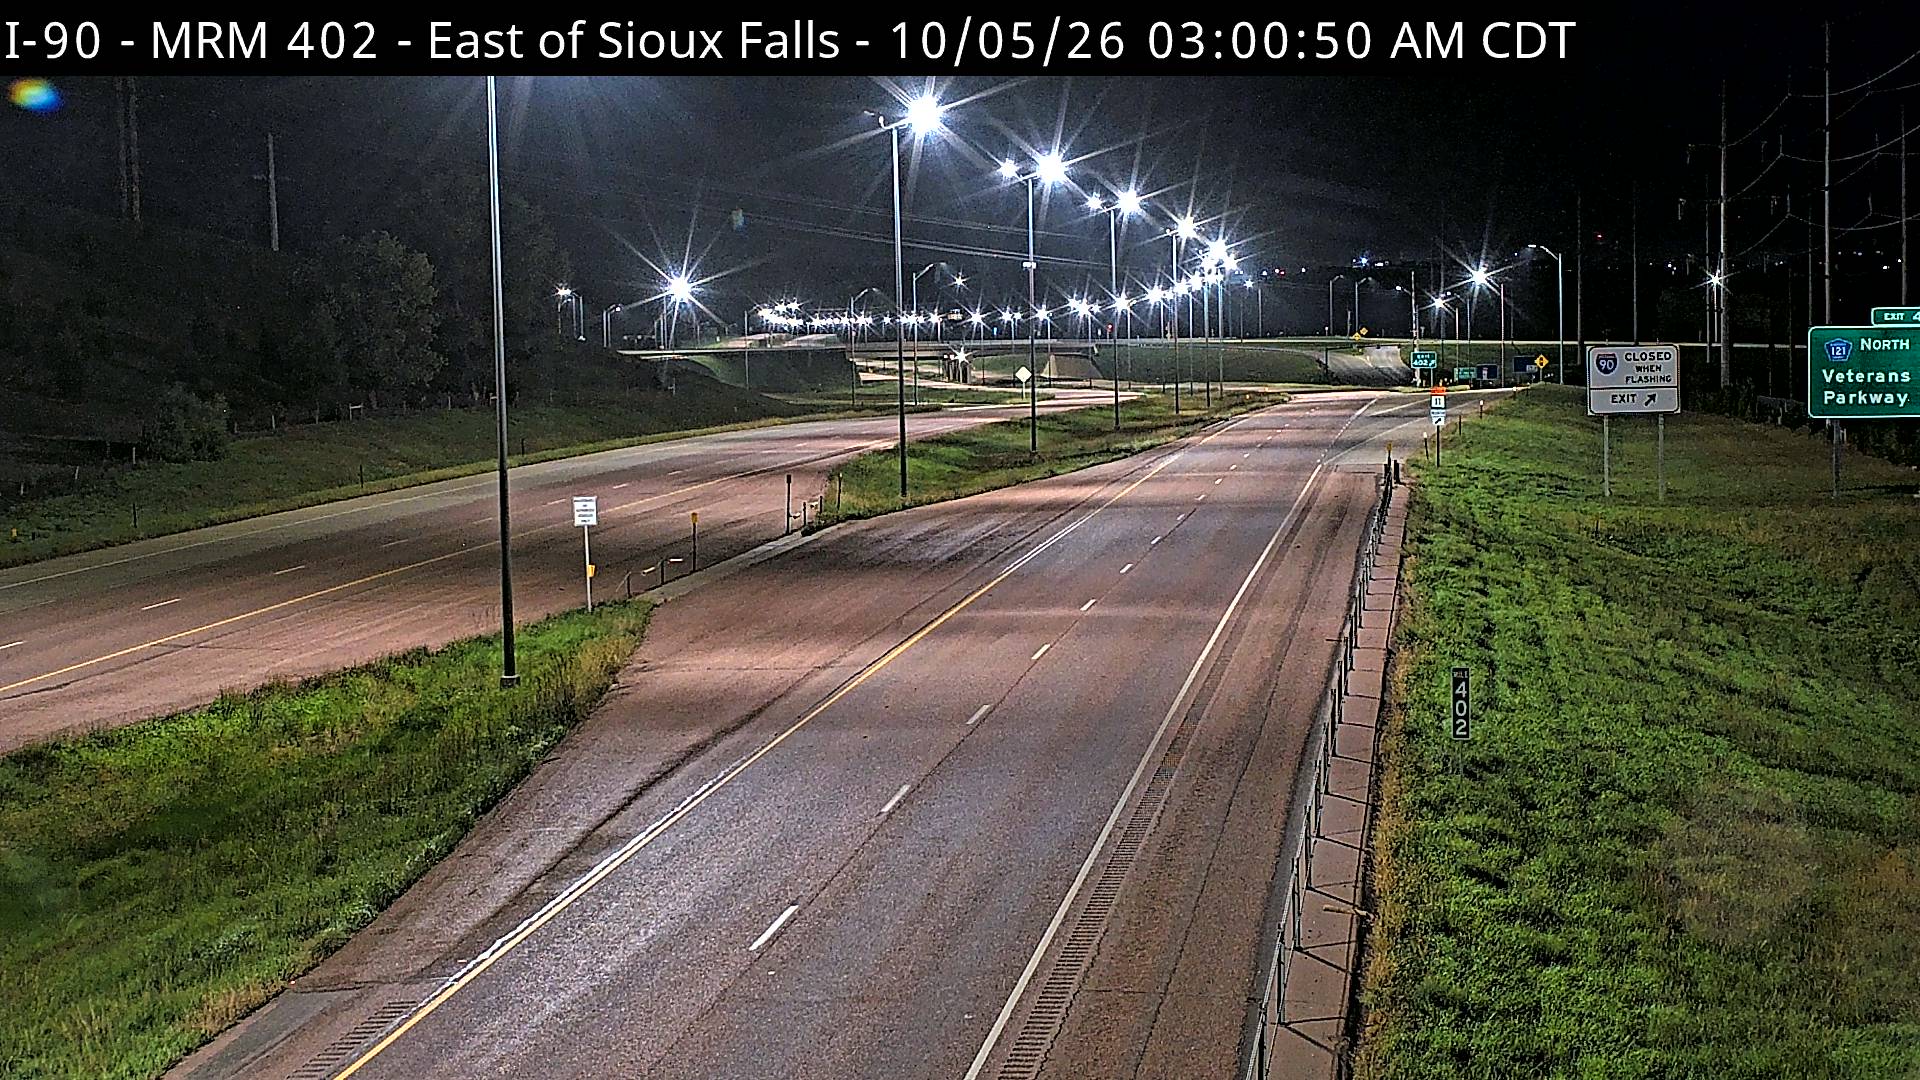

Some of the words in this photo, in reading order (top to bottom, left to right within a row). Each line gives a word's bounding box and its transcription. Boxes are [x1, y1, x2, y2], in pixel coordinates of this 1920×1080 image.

[1883, 312, 1905, 321] EXIT
[1831, 346, 1846, 356] 121
[1860, 337, 1910, 351] NORTH
[1624, 351, 1672, 362] CLOSED
[1599, 359, 1615, 371] 90
[1635, 364, 1662, 373] WHEN
[1625, 374, 1672, 385] FLASHING
[1821, 368, 1911, 383] Veterans
[1610, 393, 1637, 404] EXIT
[1823, 389, 1909, 407] Parkway
